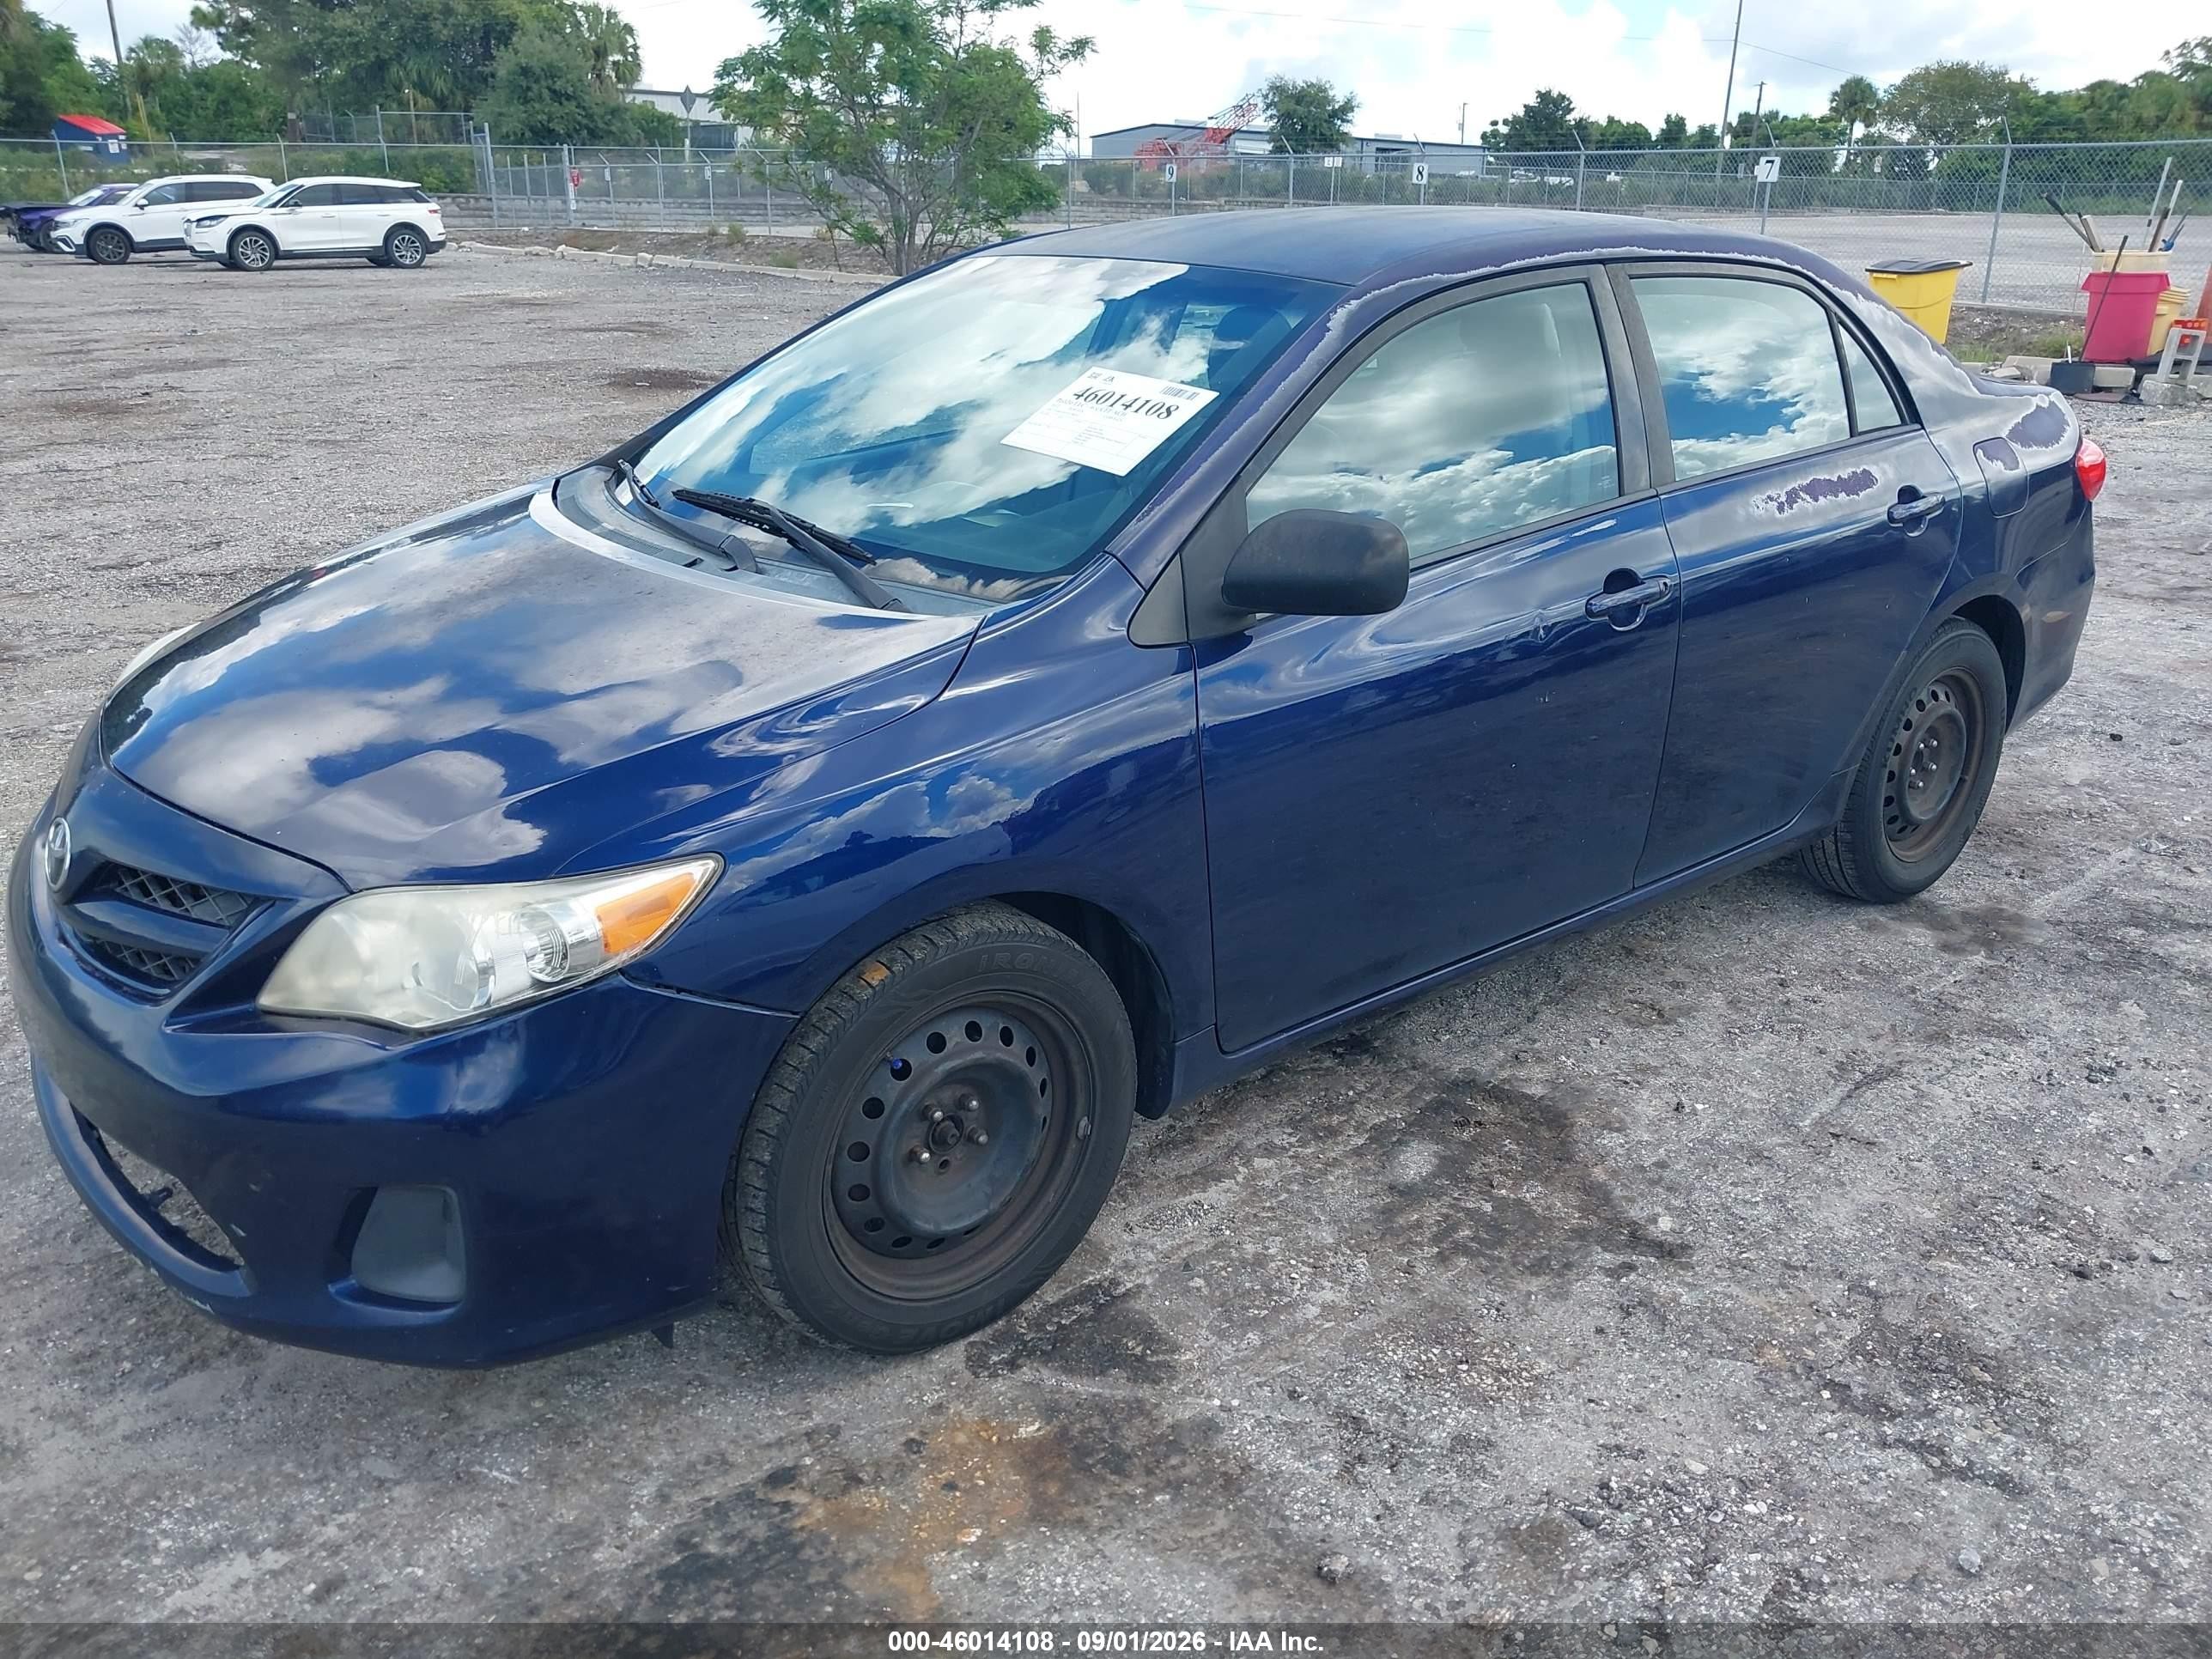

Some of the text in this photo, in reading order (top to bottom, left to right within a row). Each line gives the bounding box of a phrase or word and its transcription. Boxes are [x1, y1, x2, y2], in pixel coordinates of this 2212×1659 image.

[1167, 165, 1175, 180] 9
[1416, 165, 1425, 182] 8
[1765, 160, 1776, 179] 7
[1073, 386, 1180, 420] 46014108
